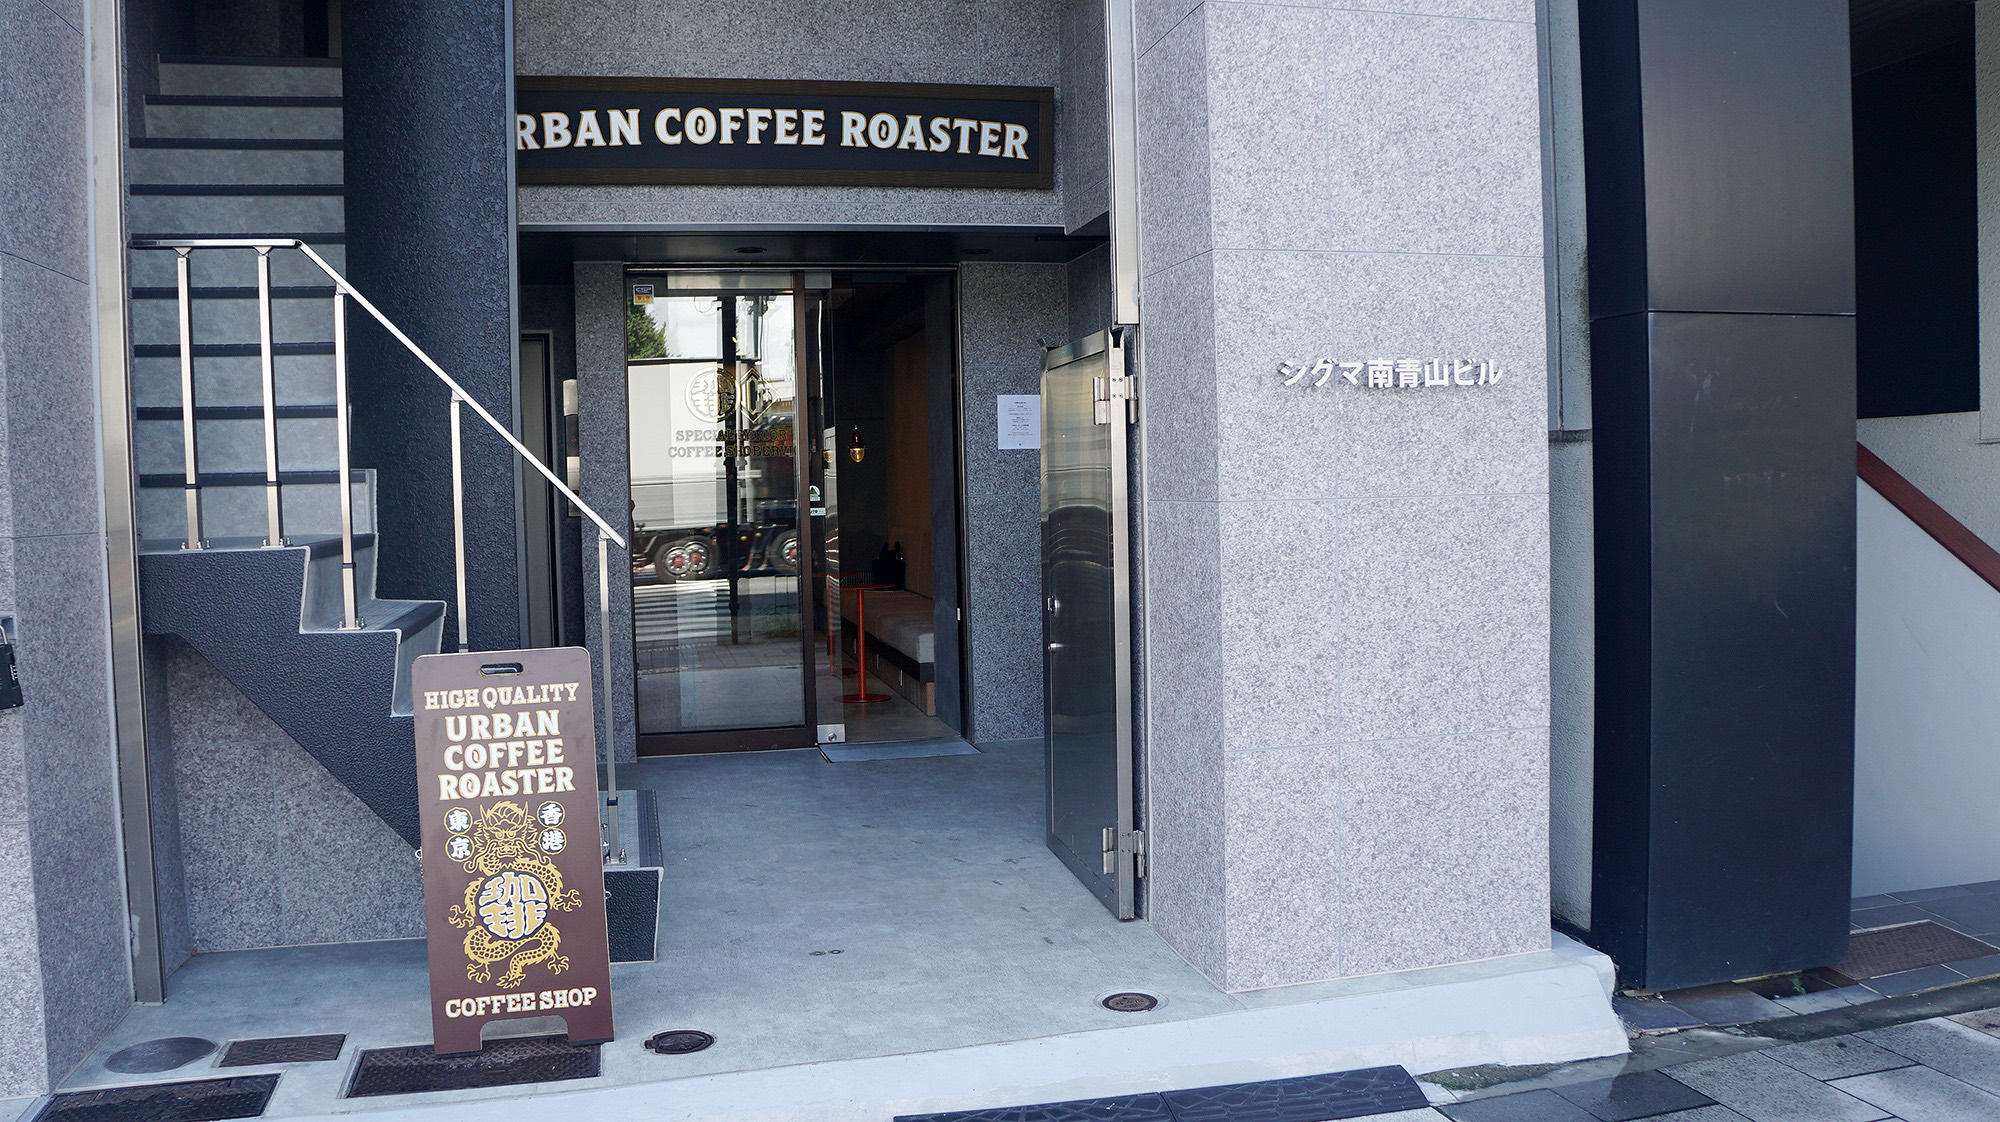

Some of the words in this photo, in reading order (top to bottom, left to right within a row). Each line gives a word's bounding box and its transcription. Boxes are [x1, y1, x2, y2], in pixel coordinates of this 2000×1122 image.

[517, 108, 642, 150] RBAN
[654, 107, 826, 146] COFFEE
[840, 111, 1030, 160] ROASTER
[1280, 357, 1504, 388] シグマ南青山ビル
[668, 446, 723, 458] COFFEE
[424, 688, 480, 710] HIGH
[482, 682, 580, 710] QUALITY
[444, 709, 561, 742] URBAN
[443, 738, 565, 771] COFFEE
[438, 766, 576, 801] ROASTER
[447, 809, 471, 859] 東京
[540, 803, 565, 852] 香港
[445, 992, 537, 1018] COFFEE
[539, 987, 598, 1011] SHOP
